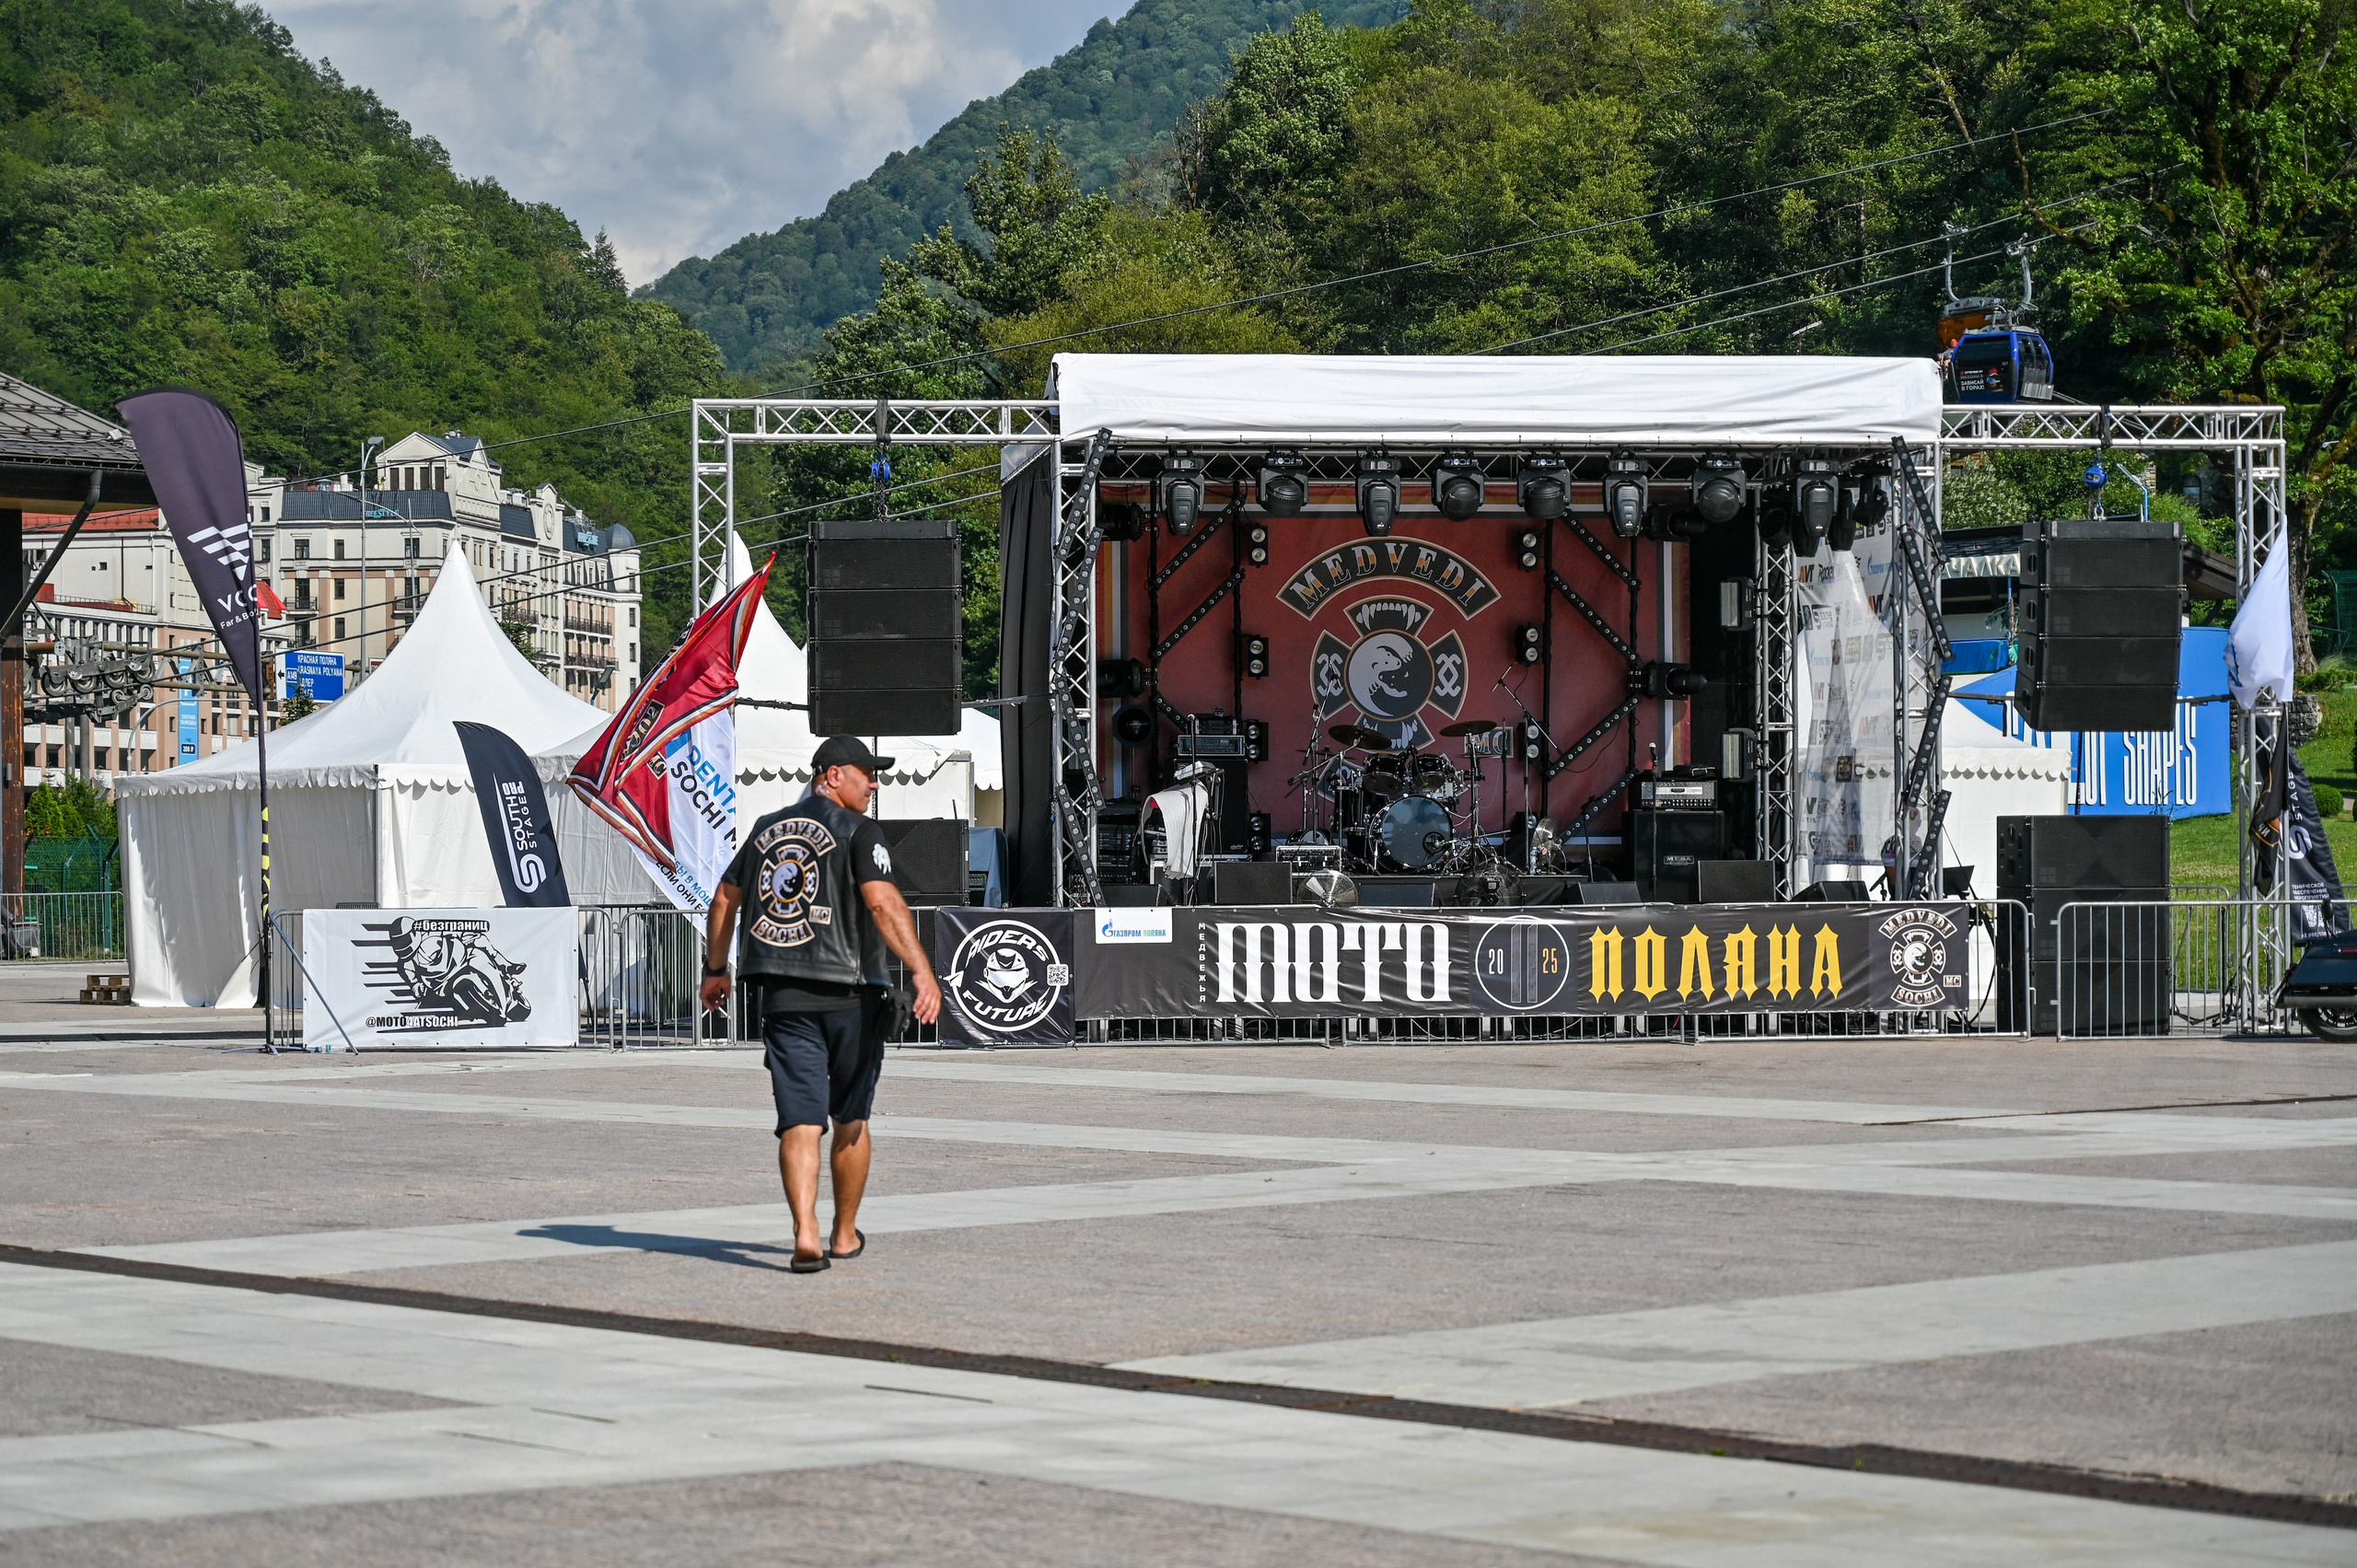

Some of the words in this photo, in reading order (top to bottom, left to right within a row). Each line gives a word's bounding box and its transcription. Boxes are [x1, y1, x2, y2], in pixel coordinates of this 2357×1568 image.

[1290, 542, 1485, 610] MEDVEDI
[220, 619, 234, 629] Far
[297, 655, 319, 664] КРАСНАЯ
[319, 656, 337, 666] ПОЛЯНА
[323, 667, 343, 677] POLYANA
[2124, 696, 2197, 806] SHAPES
[671, 761, 726, 830] SOCHI
[506, 796, 528, 851] SOUTH
[519, 796, 537, 849] STAGE
[759, 821, 830, 852] MEDVEDI
[675, 859, 688, 877] БЫ
[685, 876, 693, 884] В
[677, 884, 697, 905] ОНИ
[413, 921, 488, 932] #безграниц
[757, 921, 807, 943] SOCHI
[1884, 911, 1952, 935] MEDVEDI
[965, 930, 1050, 968] RIDERS
[1489, 948, 1504, 975] 20
[1542, 947, 1558, 974] 25
[1587, 923, 1842, 1004] ПОЛЯНА
[1945, 977, 1959, 985] MC
[963, 987, 1051, 1022] FUTURE
[1897, 989, 1940, 1004] SOCHI
